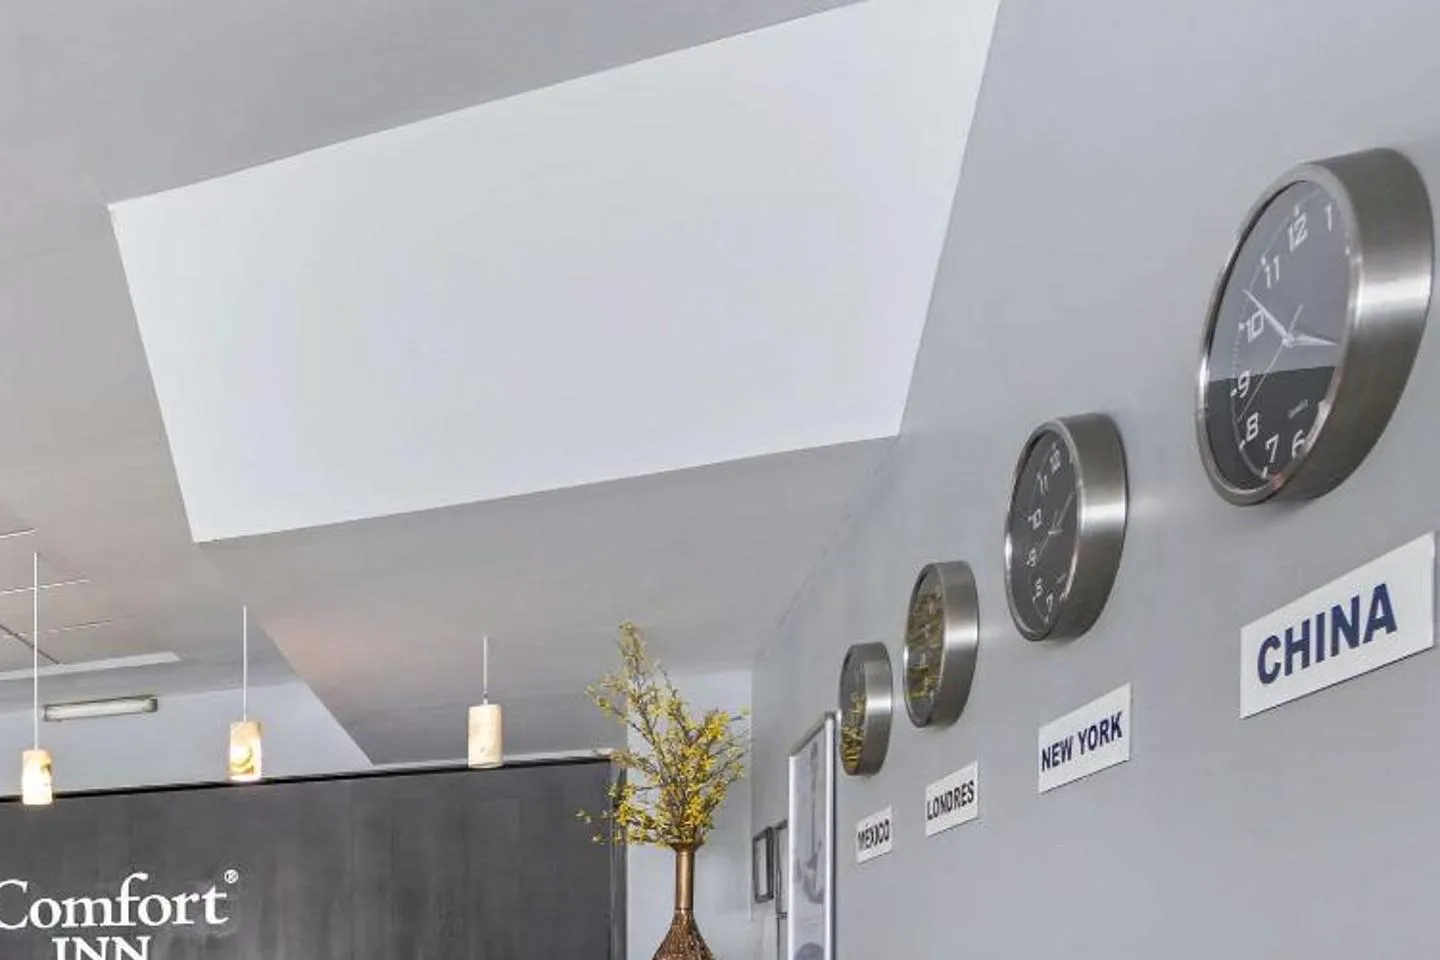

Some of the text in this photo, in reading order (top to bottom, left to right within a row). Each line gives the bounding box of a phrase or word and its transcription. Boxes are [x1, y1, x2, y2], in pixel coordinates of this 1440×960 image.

[1288, 212, 1308, 251] 12
[1264, 255, 1280, 289] 11
[1246, 309, 1264, 343] 10
[1238, 370, 1251, 398] 9
[1246, 412, 1259, 442] 8
[1265, 433, 1280, 463] 7
[1257, 583, 1397, 685] CHINA
[1042, 711, 1123, 772] NEW YORK
[927, 780, 975, 820] LONDRES
